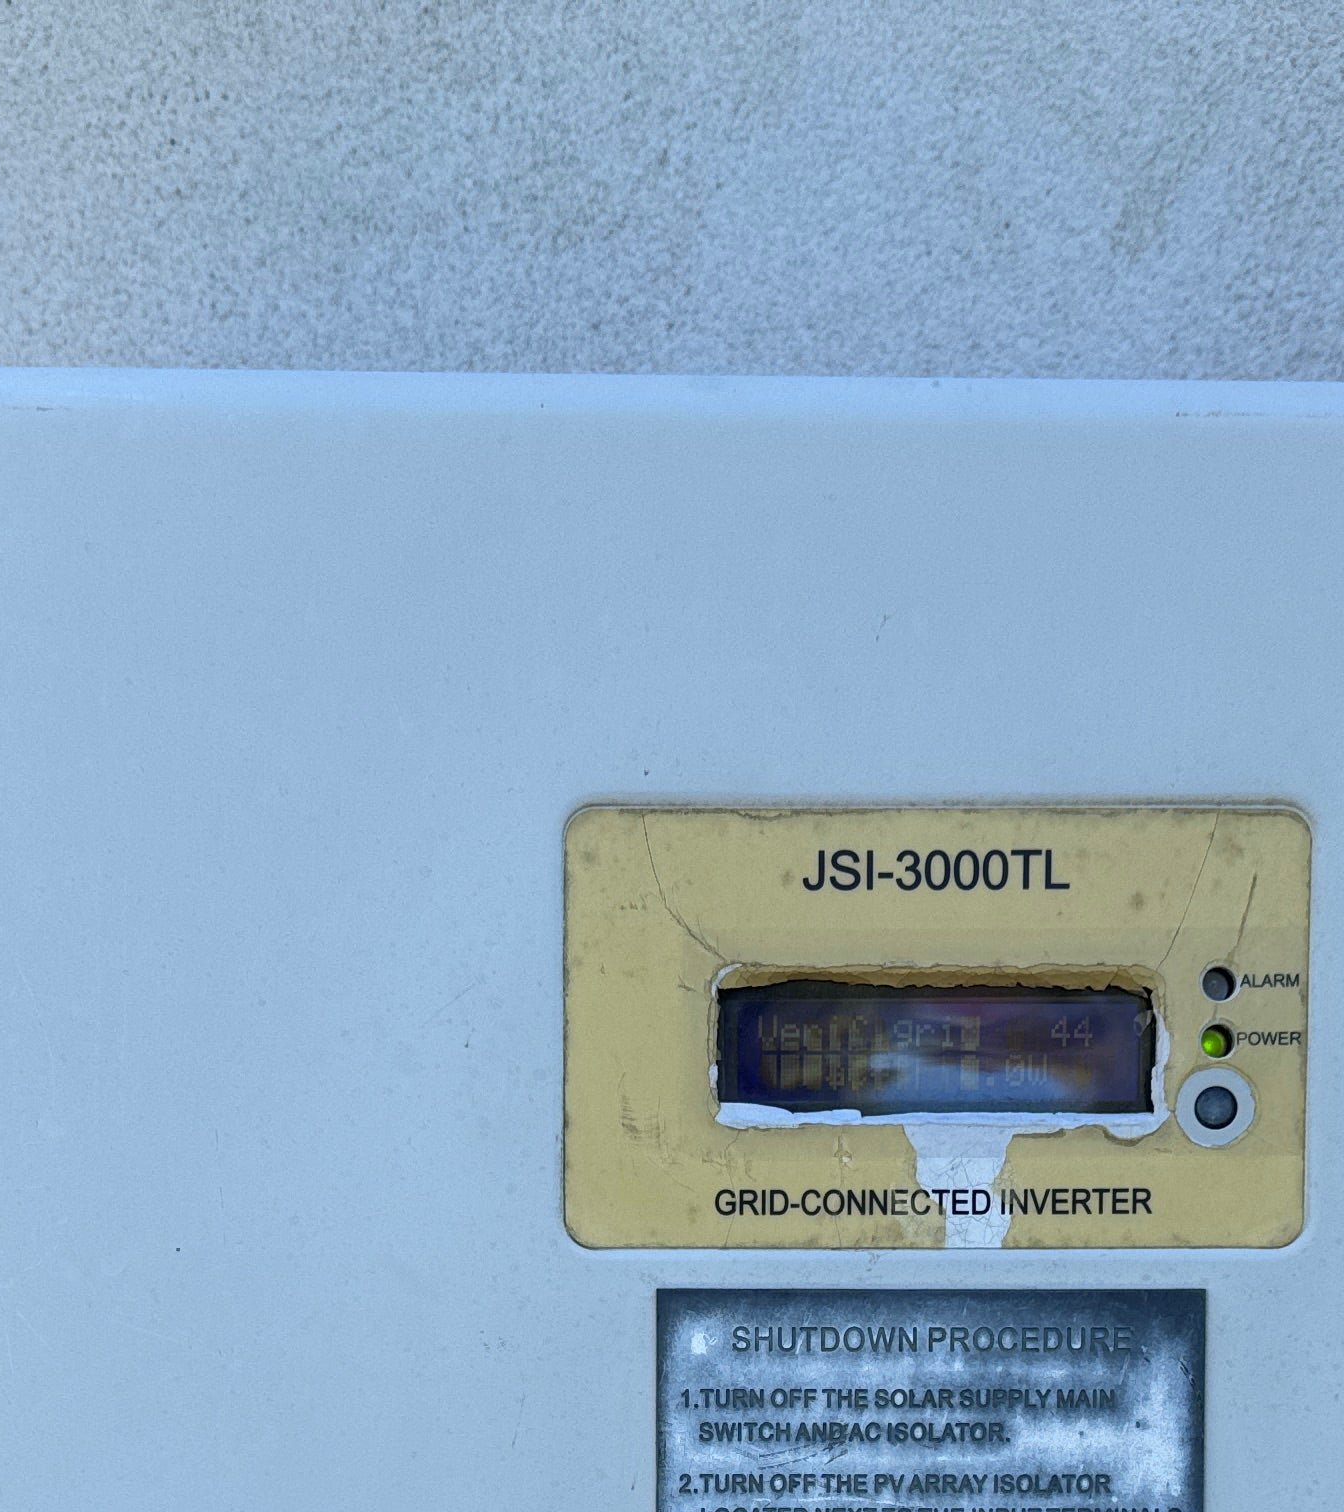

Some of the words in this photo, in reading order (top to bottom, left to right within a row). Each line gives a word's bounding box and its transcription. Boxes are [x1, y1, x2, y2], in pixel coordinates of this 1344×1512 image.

[803, 849, 1070, 891] JSI-3000TL
[1239, 973, 1300, 988] ALARM
[1236, 1031, 1302, 1046] POWER
[714, 1188, 991, 1217] GRID-CONNECTED
[1000, 1188, 1153, 1217] INVERTER
[732, 1326, 918, 1353] SHUTDOWN
[928, 1326, 1135, 1353] PROCEDURE
[770, 1388, 817, 1409] OFF
[821, 1388, 869, 1409] THE
[874, 1388, 954, 1409] SOLAR
[959, 1388, 1052, 1409] SUPPLY
[1056, 1388, 1116, 1409] MAIN
[699, 1421, 791, 1442] SWITCH
[795, 1421, 846, 1442] AND
[848, 1421, 882, 1442] AC
[887, 1421, 1011, 1442] ISOLATOR.
[770, 1473, 817, 1494] OFF
[821, 1473, 868, 1494] THE
[874, 1473, 905, 1494] PV
[908, 1473, 988, 1494] ARRAY
[993, 1473, 1112, 1494] ISOLATOR
